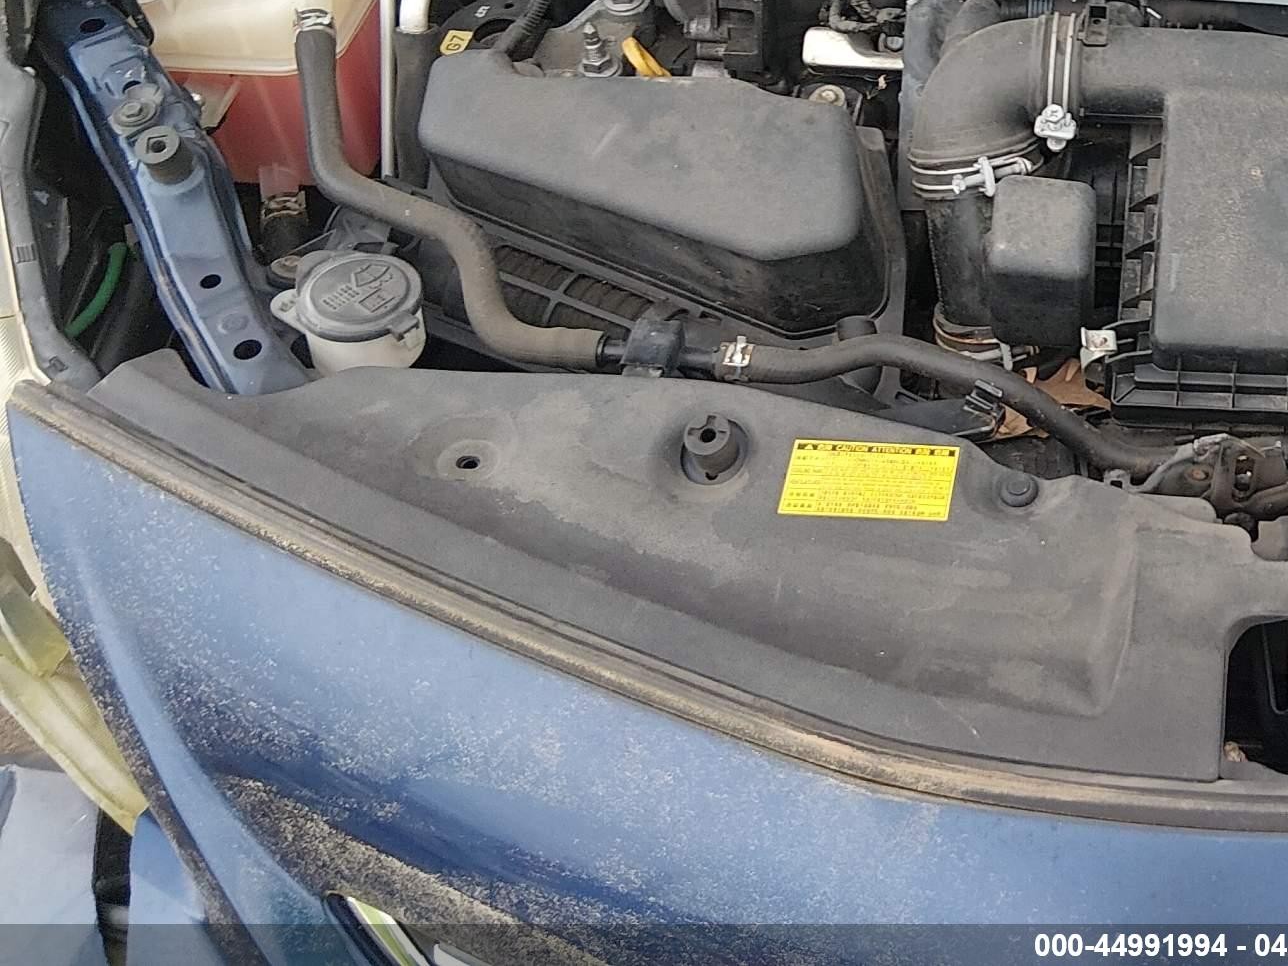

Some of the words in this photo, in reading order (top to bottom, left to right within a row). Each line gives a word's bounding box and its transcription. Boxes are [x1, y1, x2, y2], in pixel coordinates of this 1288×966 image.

[445, 34, 465, 51] G7
[835, 443, 869, 453] CAUTION
[871, 445, 913, 455] ATTENTION
